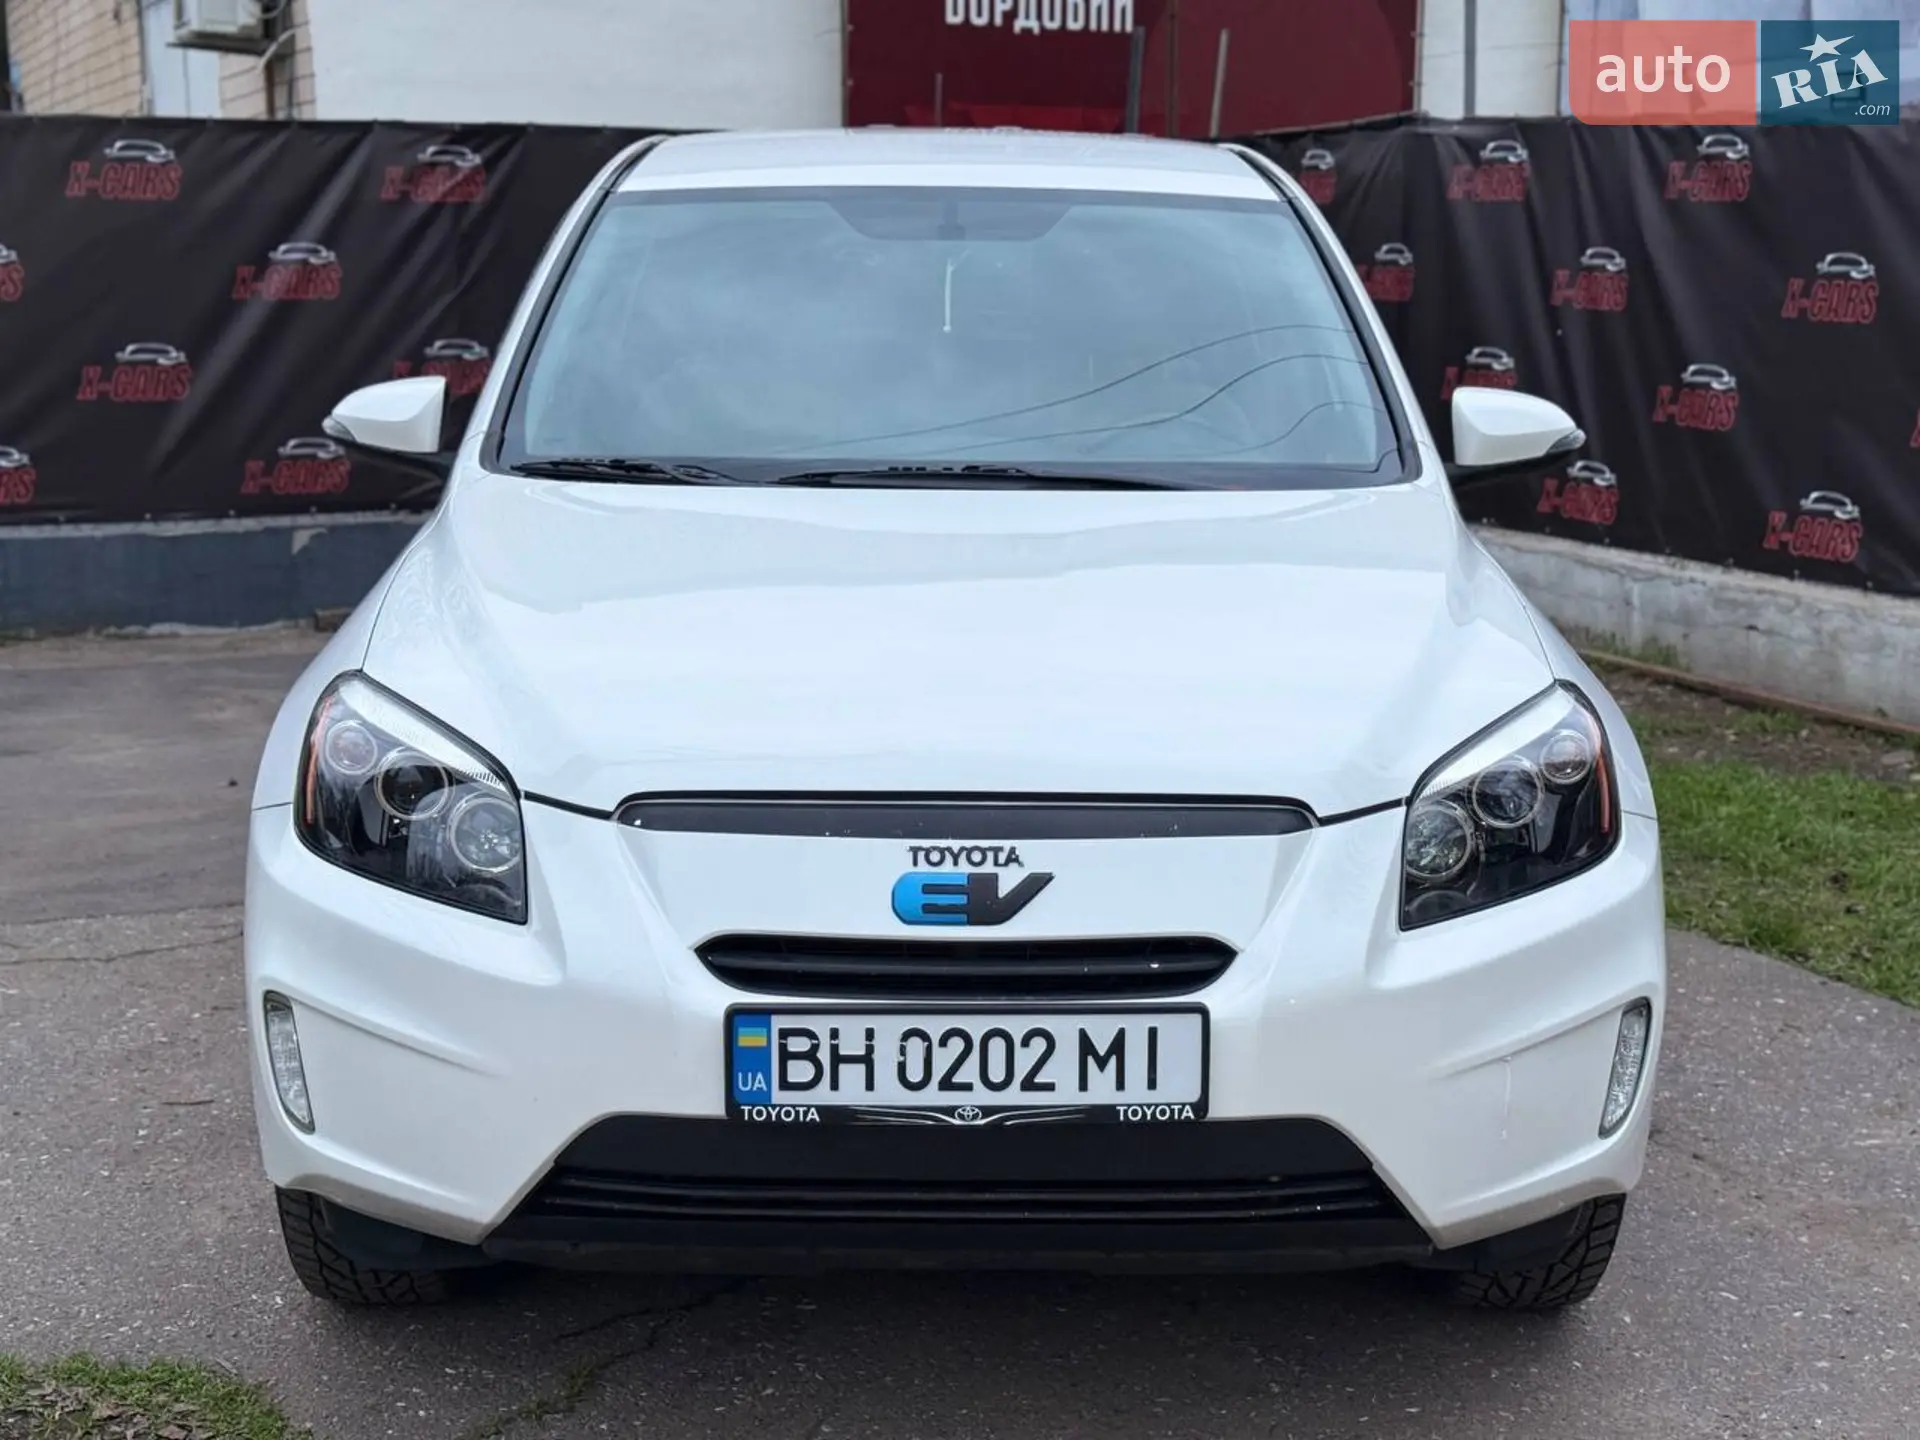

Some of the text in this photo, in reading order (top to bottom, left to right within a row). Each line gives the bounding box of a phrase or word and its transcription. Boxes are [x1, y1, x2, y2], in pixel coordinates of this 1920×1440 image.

[908, 845, 1024, 868] TOYOTA
[891, 871, 1055, 926] EV
[777, 1027, 1159, 1092] BH 0202 MI
[737, 1072, 768, 1092] UA
[741, 1106, 821, 1123] TOYOTA
[1116, 1104, 1195, 1122] TOYOTA
